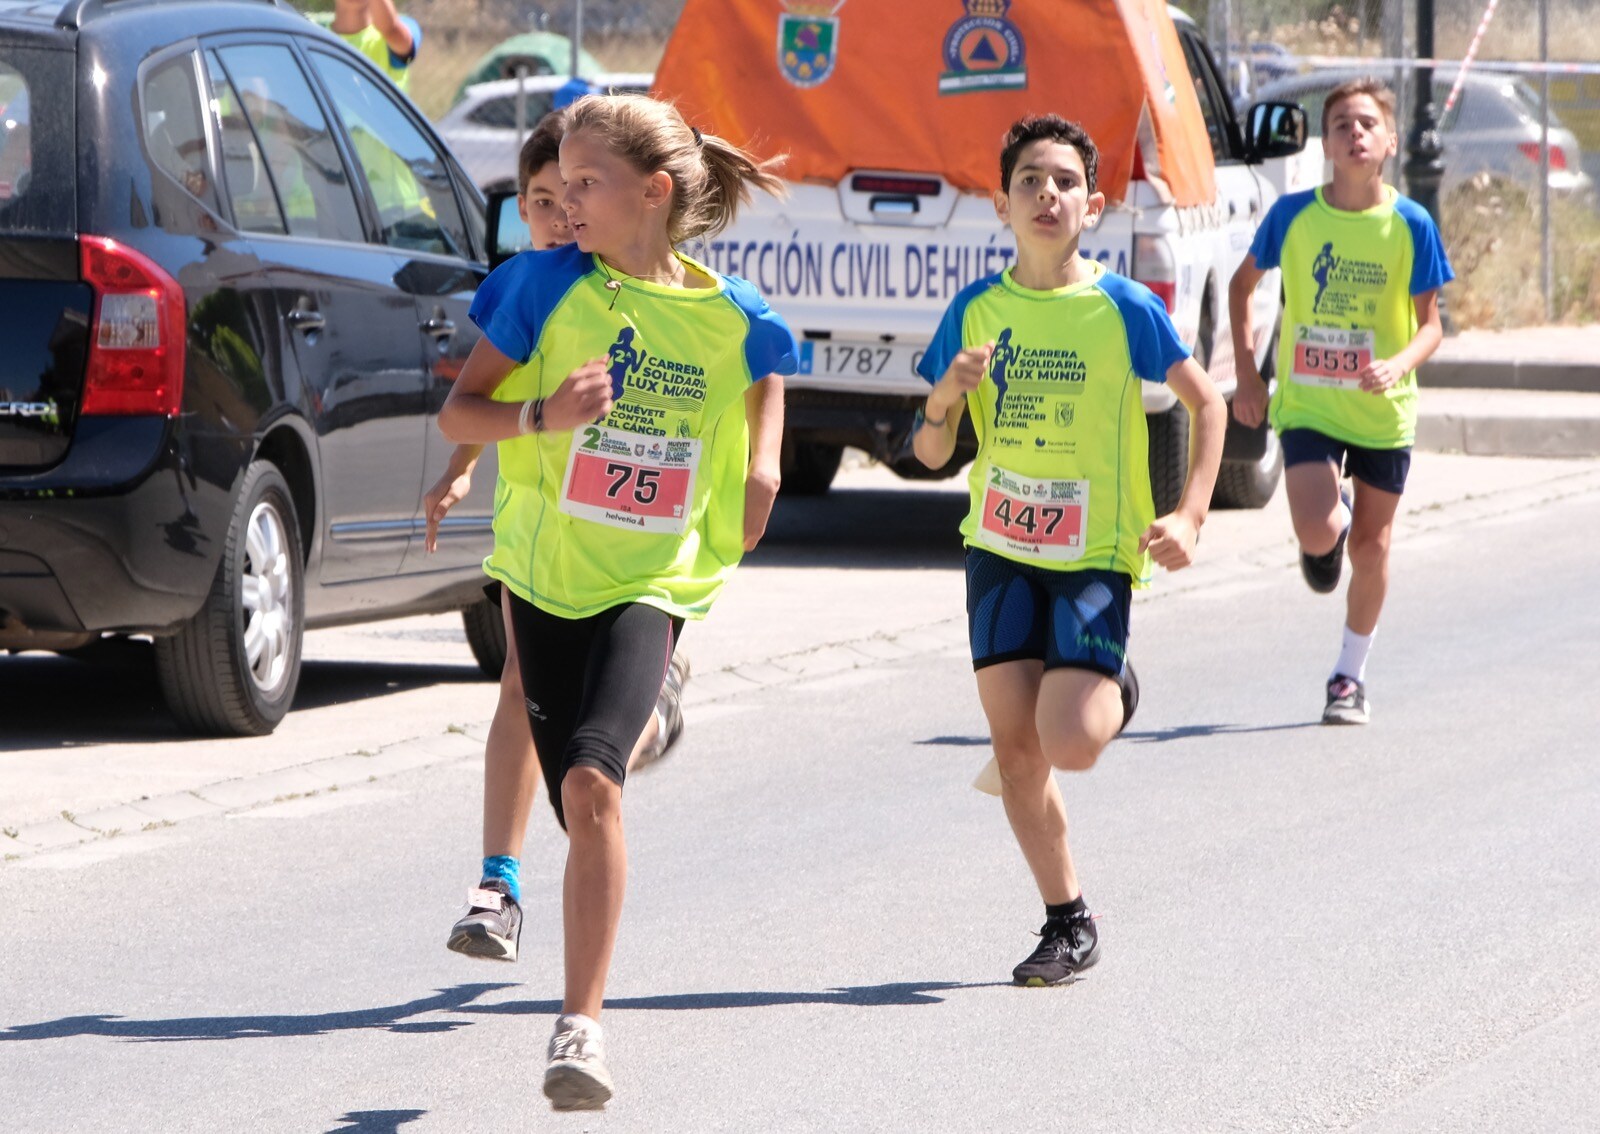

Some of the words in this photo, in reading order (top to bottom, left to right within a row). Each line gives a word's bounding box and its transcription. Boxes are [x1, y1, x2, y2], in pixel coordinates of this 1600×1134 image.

[831, 242, 897, 297] CIVIL
[1340, 267, 1387, 277] SOLIDARIA
[1342, 260, 1383, 270] CARRERA
[1329, 273, 1349, 282] LUX
[1352, 276, 1387, 285] MUNDI
[824, 346, 892, 374] 1787
[1023, 349, 1078, 359] CARRERA
[1306, 347, 1358, 372] 553
[648, 357, 704, 376] CARRERA
[1019, 359, 1086, 370] SOLIDARIA
[1007, 370, 1033, 379] LUX
[1038, 371, 1086, 382] MUNDI
[626, 375, 659, 393] LUX
[662, 384, 707, 402] MUNDI
[611, 410, 654, 425] CONTRA
[616, 402, 665, 418] MUÉVETE
[607, 419, 619, 428] EL
[623, 422, 666, 437] CÁNCER
[999, 420, 1028, 429] UVENIL
[607, 463, 661, 504] 75
[606, 511, 636, 524] helvetia
[994, 498, 1064, 536] 447
